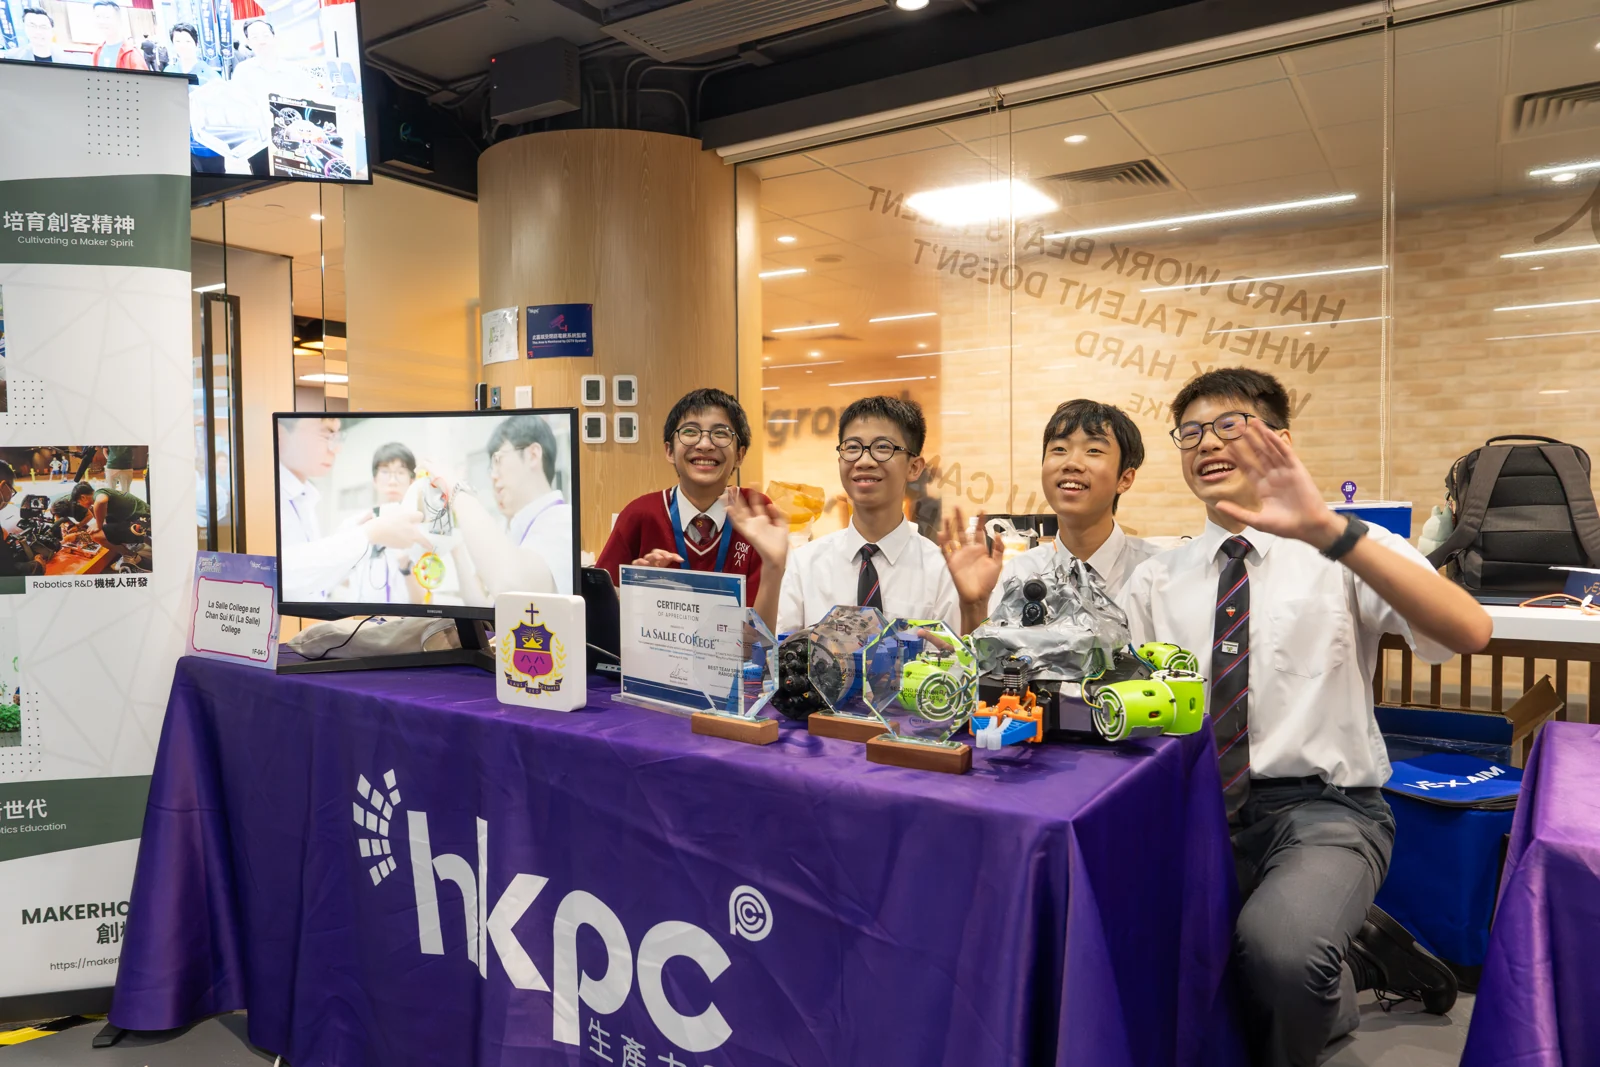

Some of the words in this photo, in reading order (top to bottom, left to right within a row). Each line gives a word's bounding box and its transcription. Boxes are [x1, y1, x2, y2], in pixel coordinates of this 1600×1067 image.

[3, 211, 135, 235] 培育創客精神
[17, 235, 69, 247] Cultivating
[79, 238, 108, 247] Maker
[110, 238, 134, 249] Spirit
[33, 580, 73, 588] Robotics
[74, 579, 94, 588] R&D
[94, 577, 148, 588] 機械人研發
[1583, 581, 1600, 596] VE
[207, 600, 215, 608] La
[215, 602, 229, 610] Salle
[228, 603, 249, 614] College
[249, 605, 260, 614] and
[656, 600, 700, 613] CERTIFICATE
[205, 611, 219, 620] Chan
[219, 612, 228, 621] Sui
[228, 613, 235, 622] Ki
[235, 615, 244, 624] (La
[244, 616, 261, 627] Salle)
[665, 612, 700, 622] APPRECIATION
[220, 624, 241, 635] College
[716, 623, 728, 633] IET
[652, 629, 677, 643] SALLE
[1466, 765, 1506, 784] AIM
[0, 825, 18, 834] tics
[20, 822, 67, 833] Education
[406, 810, 733, 1053] hkpc
